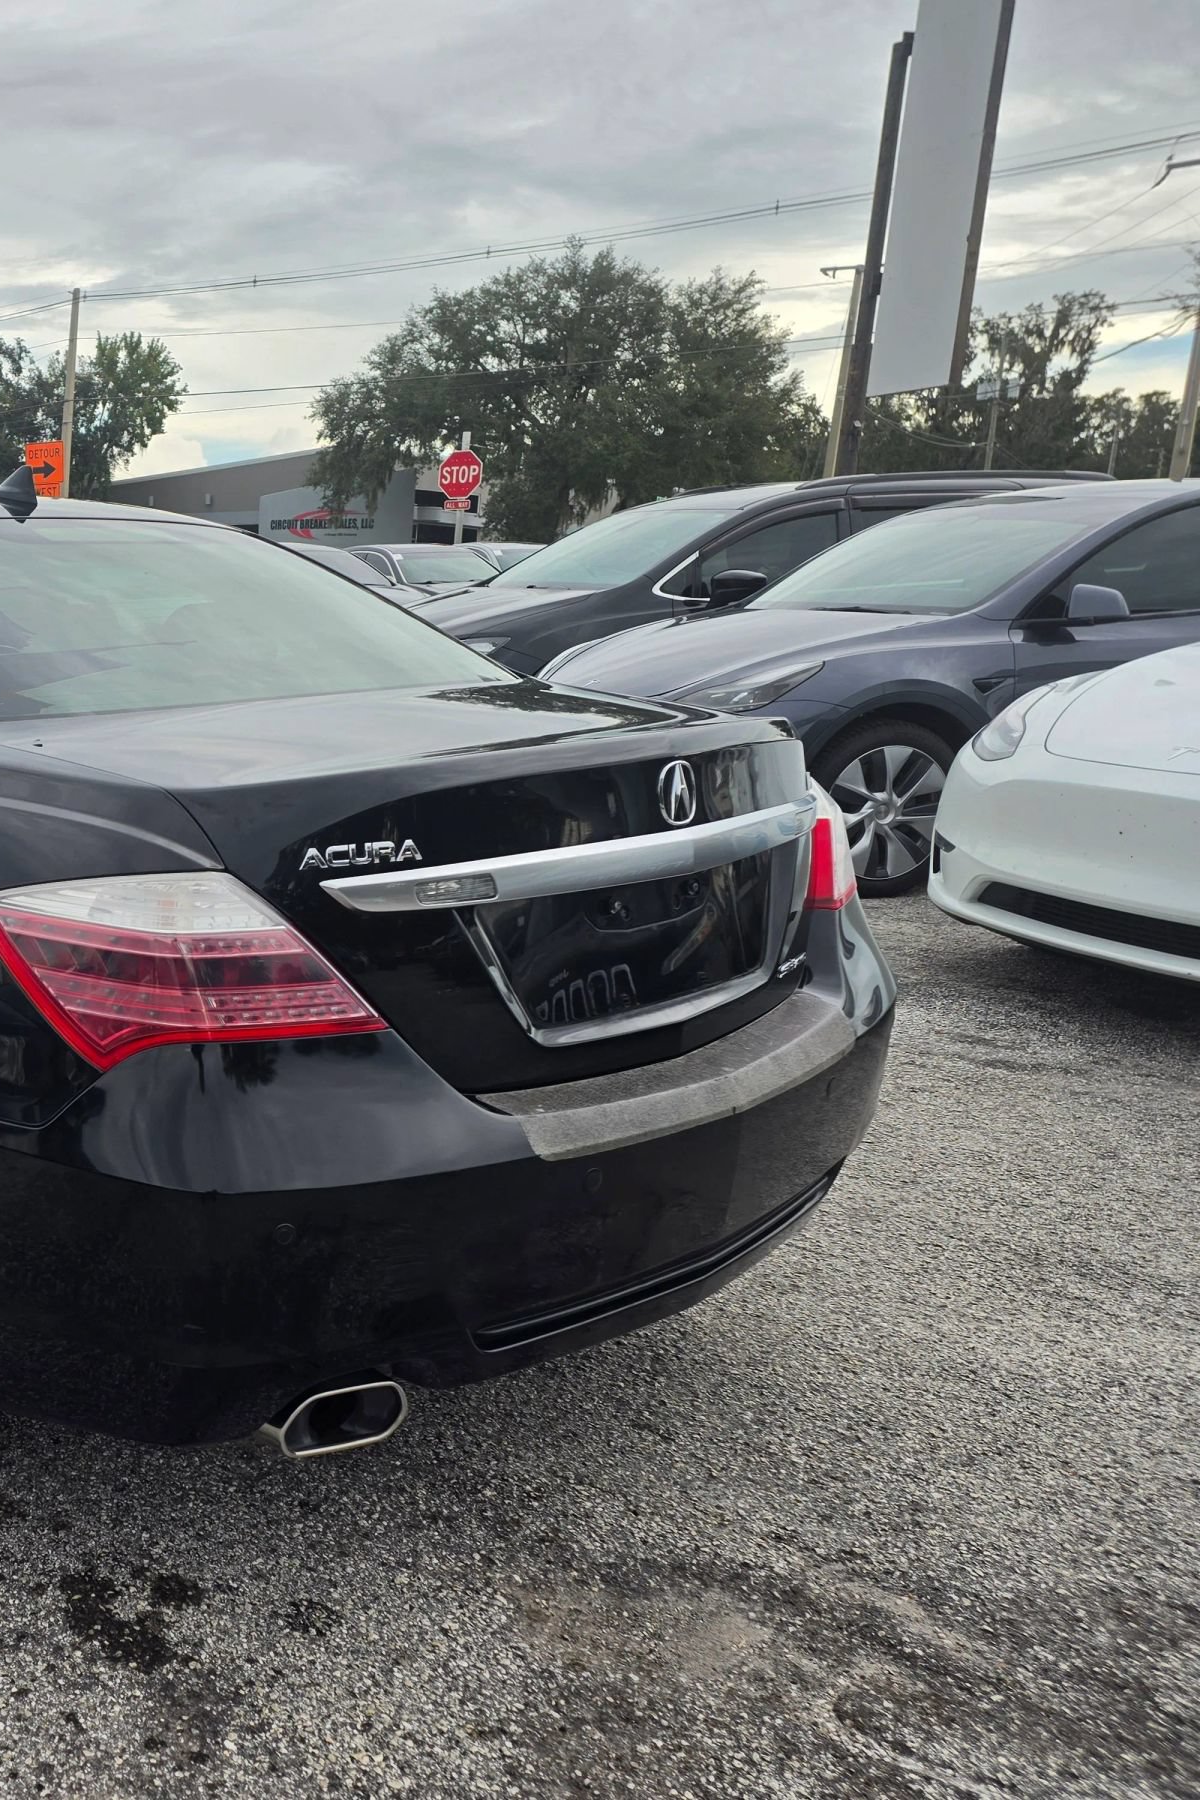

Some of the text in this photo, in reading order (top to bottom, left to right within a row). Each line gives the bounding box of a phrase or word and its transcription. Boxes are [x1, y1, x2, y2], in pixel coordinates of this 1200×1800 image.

[28, 448, 60, 460] DETOUR
[441, 465, 479, 484] STOP
[270, 519, 298, 530] CIRCUIT
[334, 518, 359, 531] ALES,
[361, 518, 375, 529] LLC
[299, 839, 423, 870] ACURA
